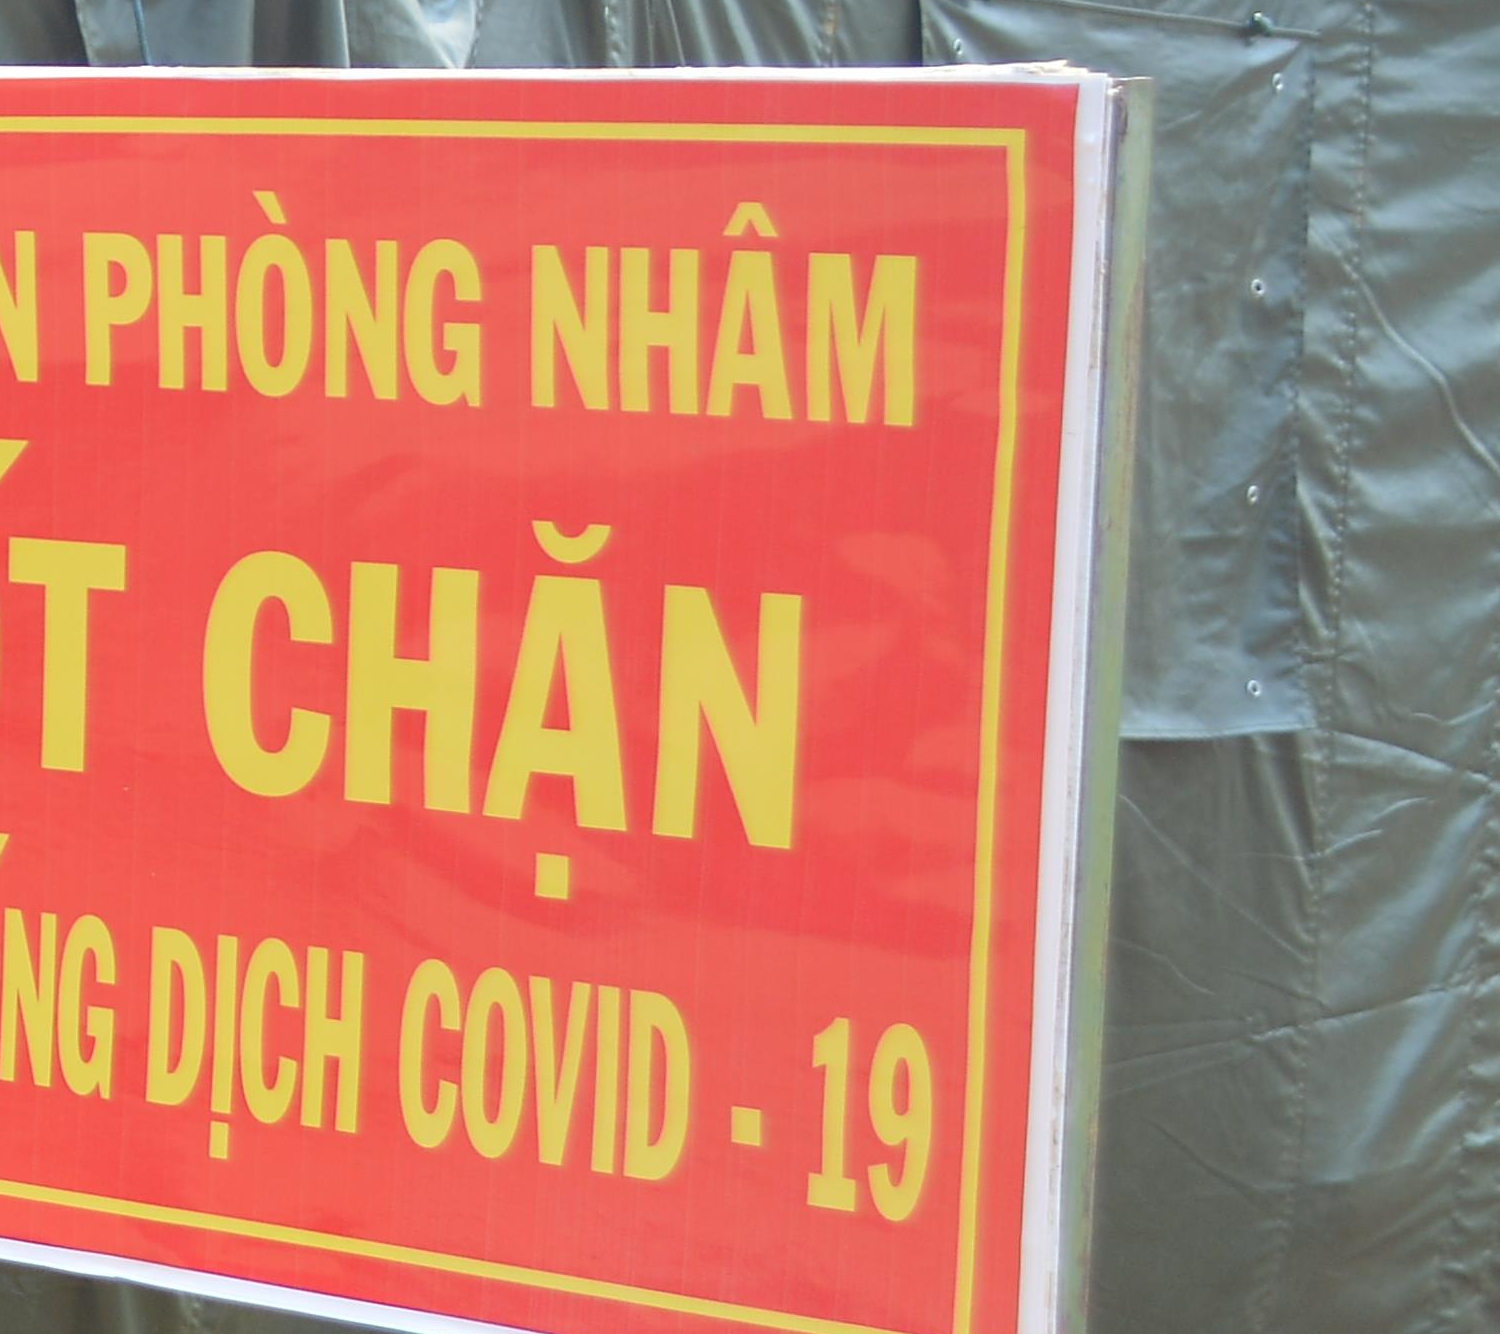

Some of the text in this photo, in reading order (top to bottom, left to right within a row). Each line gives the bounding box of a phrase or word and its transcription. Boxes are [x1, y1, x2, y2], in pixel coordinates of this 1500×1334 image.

[81, 189, 485, 409] PHÒNG
[529, 200, 920, 429] NHÂM
[202, 519, 805, 902] CHẶN
[144, 925, 367, 1162] DỊCH
[397, 957, 695, 1183] COVID
[730, 1105, 766, 1149] -
[806, 1016, 936, 1224] 19
